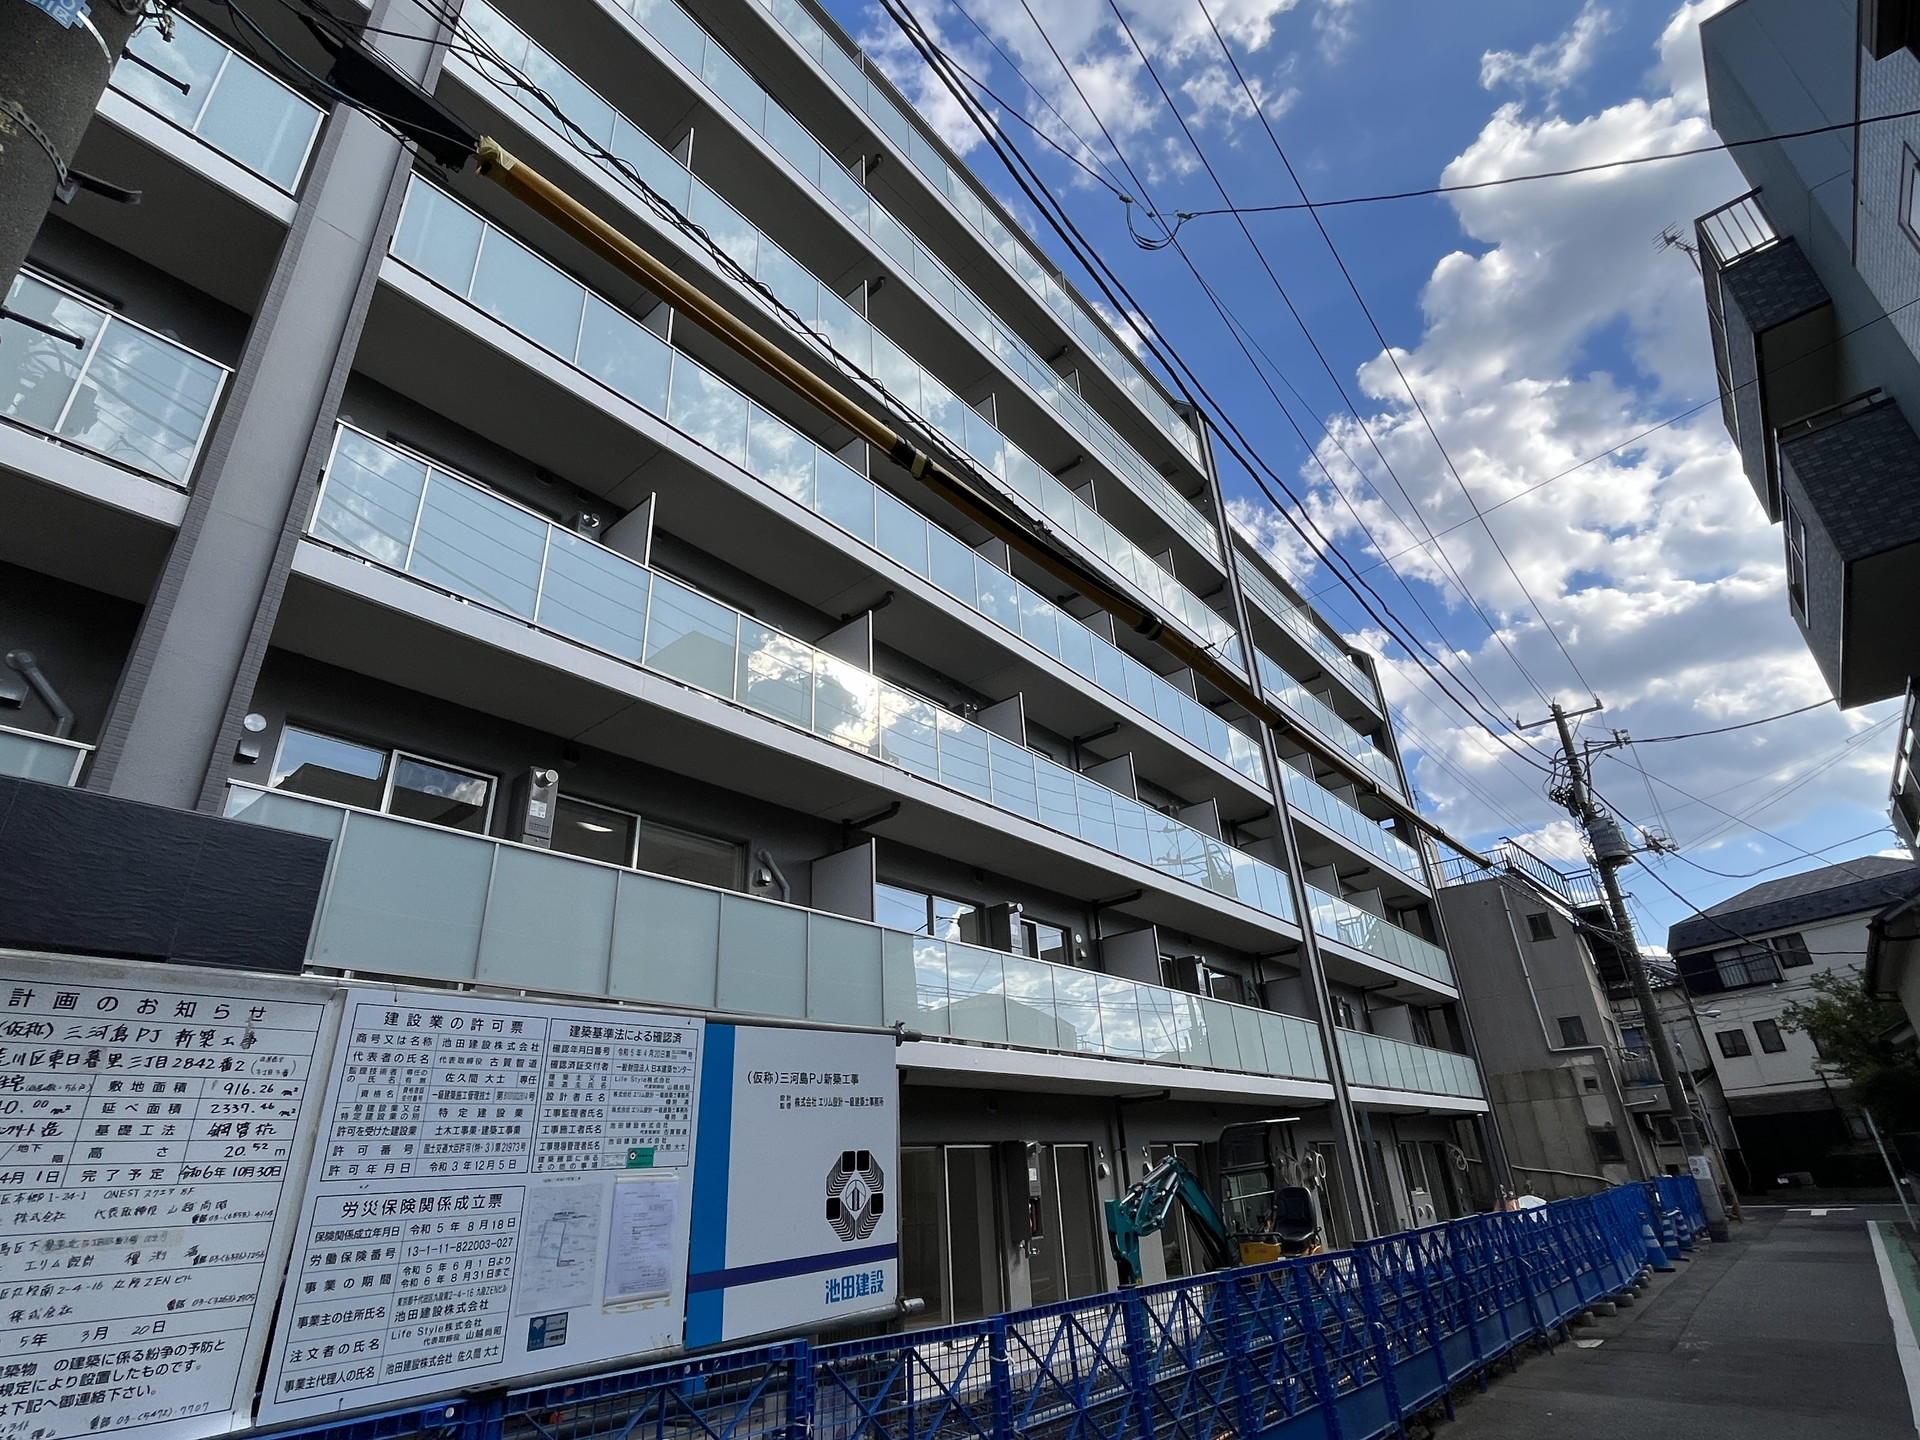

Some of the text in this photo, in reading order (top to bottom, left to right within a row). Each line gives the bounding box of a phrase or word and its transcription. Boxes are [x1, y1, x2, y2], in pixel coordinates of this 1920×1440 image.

[384, 1011, 524, 1034] 建設業の許可票
[356, 1033, 433, 1047] 商号又は名称
[569, 1025, 682, 1044] 建築基準法による確認済
[442, 1038, 540, 1052] 池田建設株式会社
[353, 1051, 429, 1065] 代表者の氏名
[108, 1080, 188, 1093] 敷地面積
[101, 1102, 182, 1114] 延べ面積
[438, 1107, 523, 1118] 特定建設業
[94, 1124, 176, 1137] 基礎工法
[332, 1143, 414, 1156] 許可番号
[81, 1168, 165, 1182] 完了予定
[328, 1163, 411, 1176] 許可年月日
[341, 1193, 503, 1218] 労災保険関係成立票
[407, 1237, 514, 1257] 13-1-11-822003-027
[310, 1247, 396, 1267] 労働保険番号
[304, 1273, 392, 1295] 事業の期間
[825, 1269, 884, 1304] 池田建設
[394, 1298, 489, 1323] 池田建設株式会社
[391, 1329, 412, 1340] Life
[289, 1338, 380, 1363] 注文者の氏名
